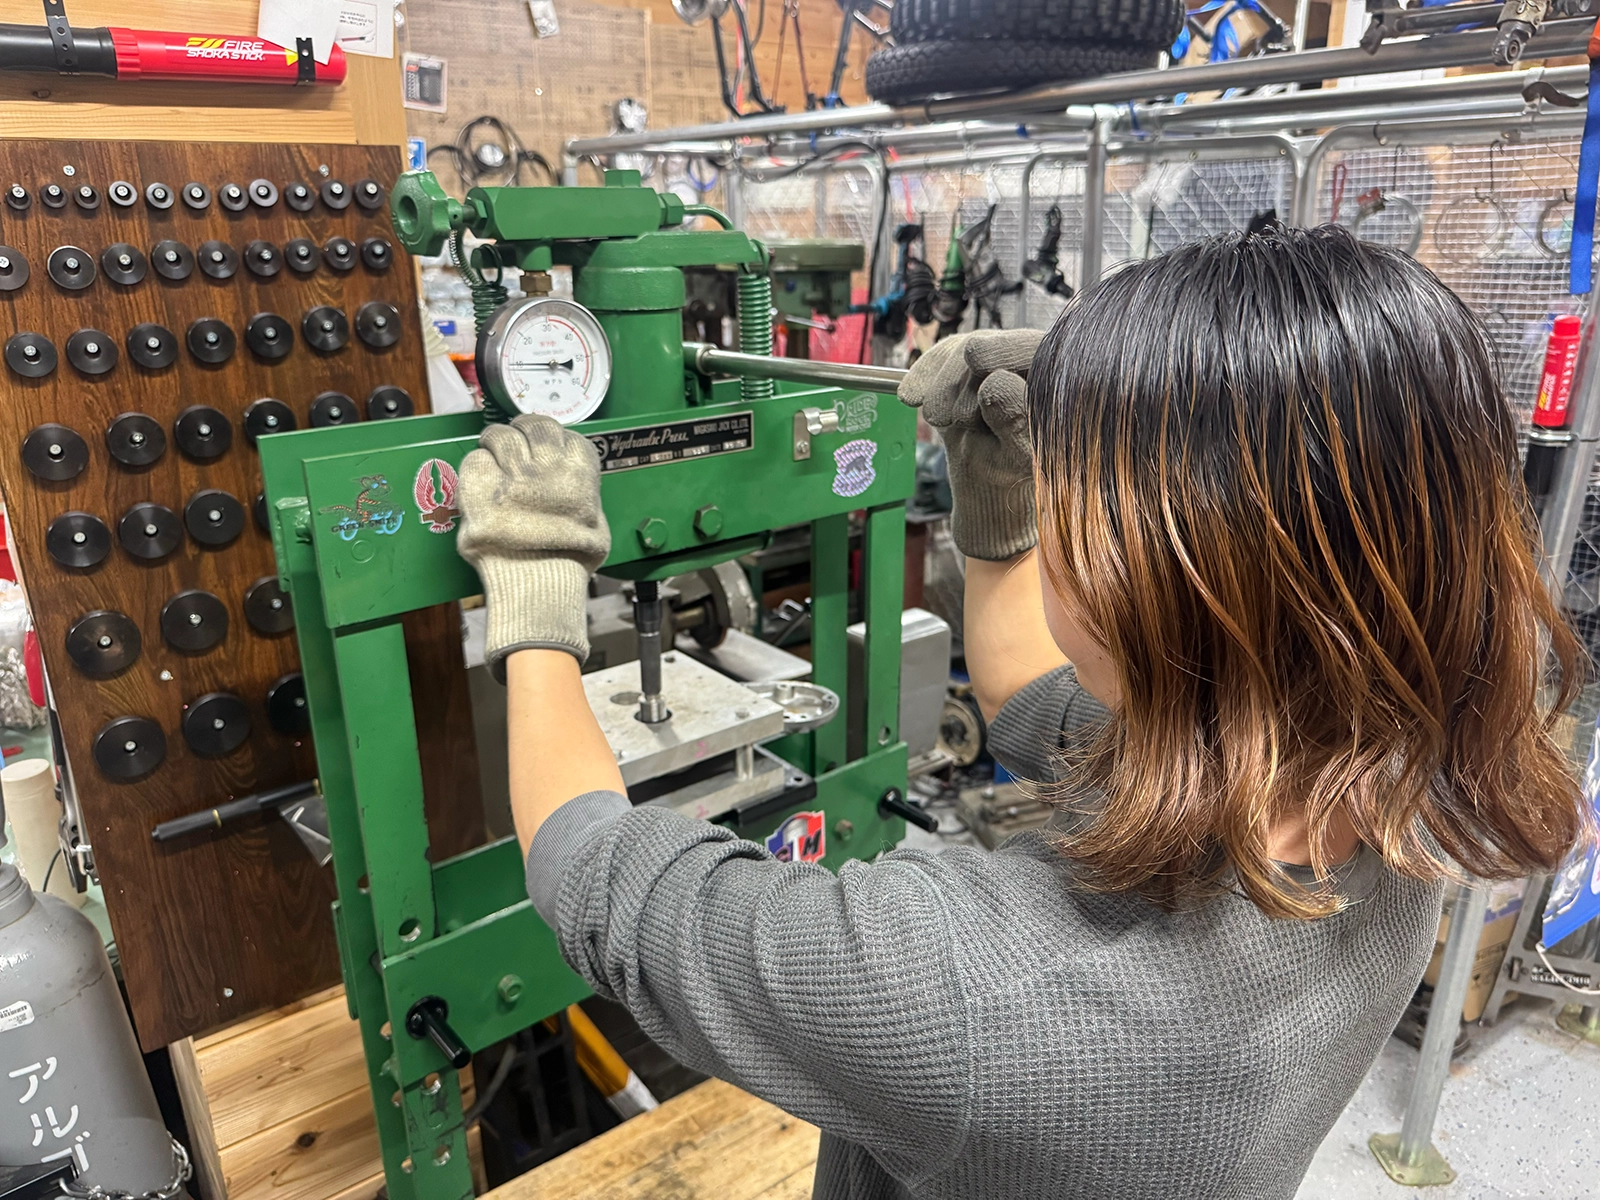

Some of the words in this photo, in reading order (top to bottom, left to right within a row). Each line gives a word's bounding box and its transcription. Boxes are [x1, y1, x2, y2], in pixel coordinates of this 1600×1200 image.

[224, 40, 264, 51] FIRE
[543, 325, 552, 333] 30
[524, 337, 532, 345] 20
[565, 333, 573, 341] 40
[576, 354, 584, 362] 50
[331, 520, 365, 533] GREEN
